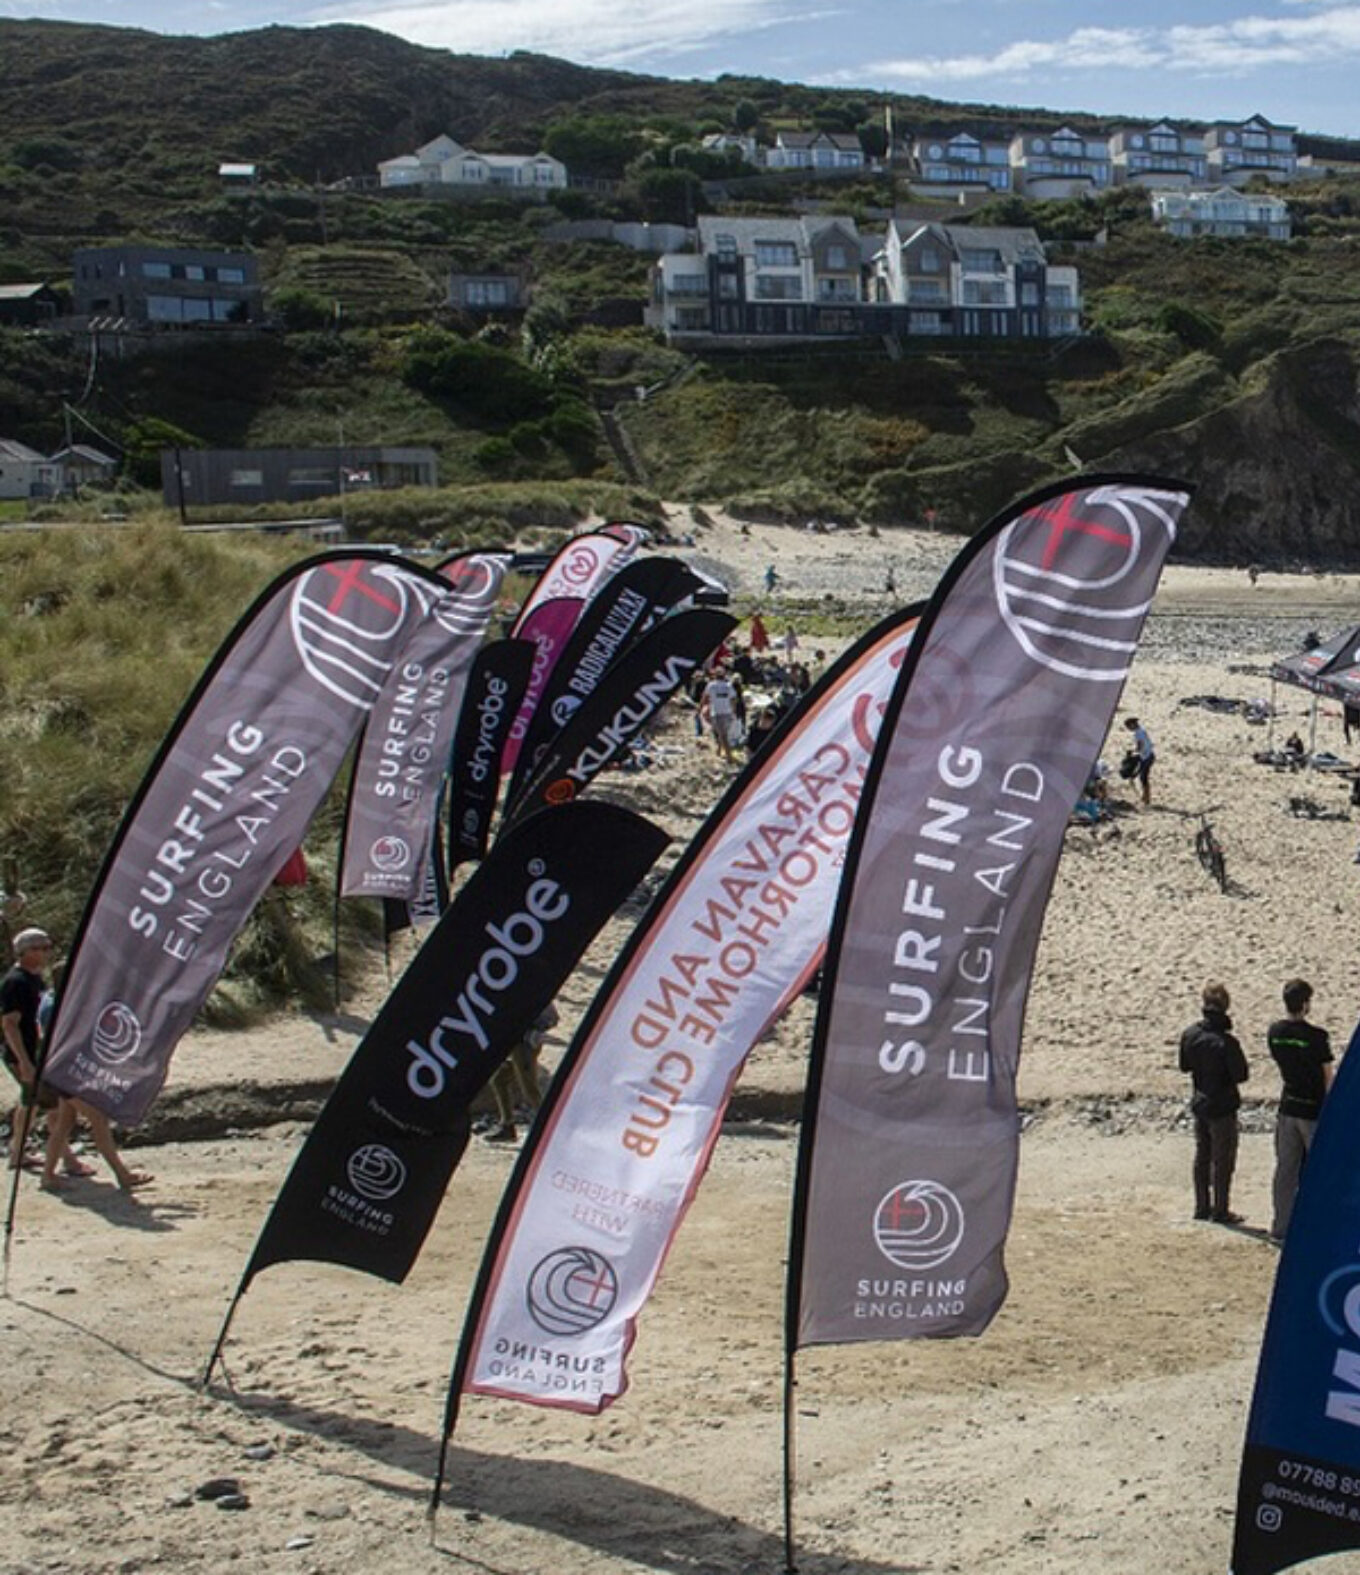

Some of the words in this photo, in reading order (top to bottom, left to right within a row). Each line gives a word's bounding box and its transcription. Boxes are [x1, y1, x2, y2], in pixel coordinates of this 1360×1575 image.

[376, 662, 423, 797] SURFING
[403, 667, 447, 801] ENGLAND
[128, 718, 264, 939] SURFING
[162, 744, 306, 962] ENGLAND
[878, 743, 982, 1077] SURFING
[947, 762, 1044, 1082] ENGLAND
[329, 1184, 393, 1224] SURFING
[854, 1300, 964, 1318] ENGLAND
[857, 1278, 966, 1297] SURFING
[1278, 1460, 1338, 1490] 07788
